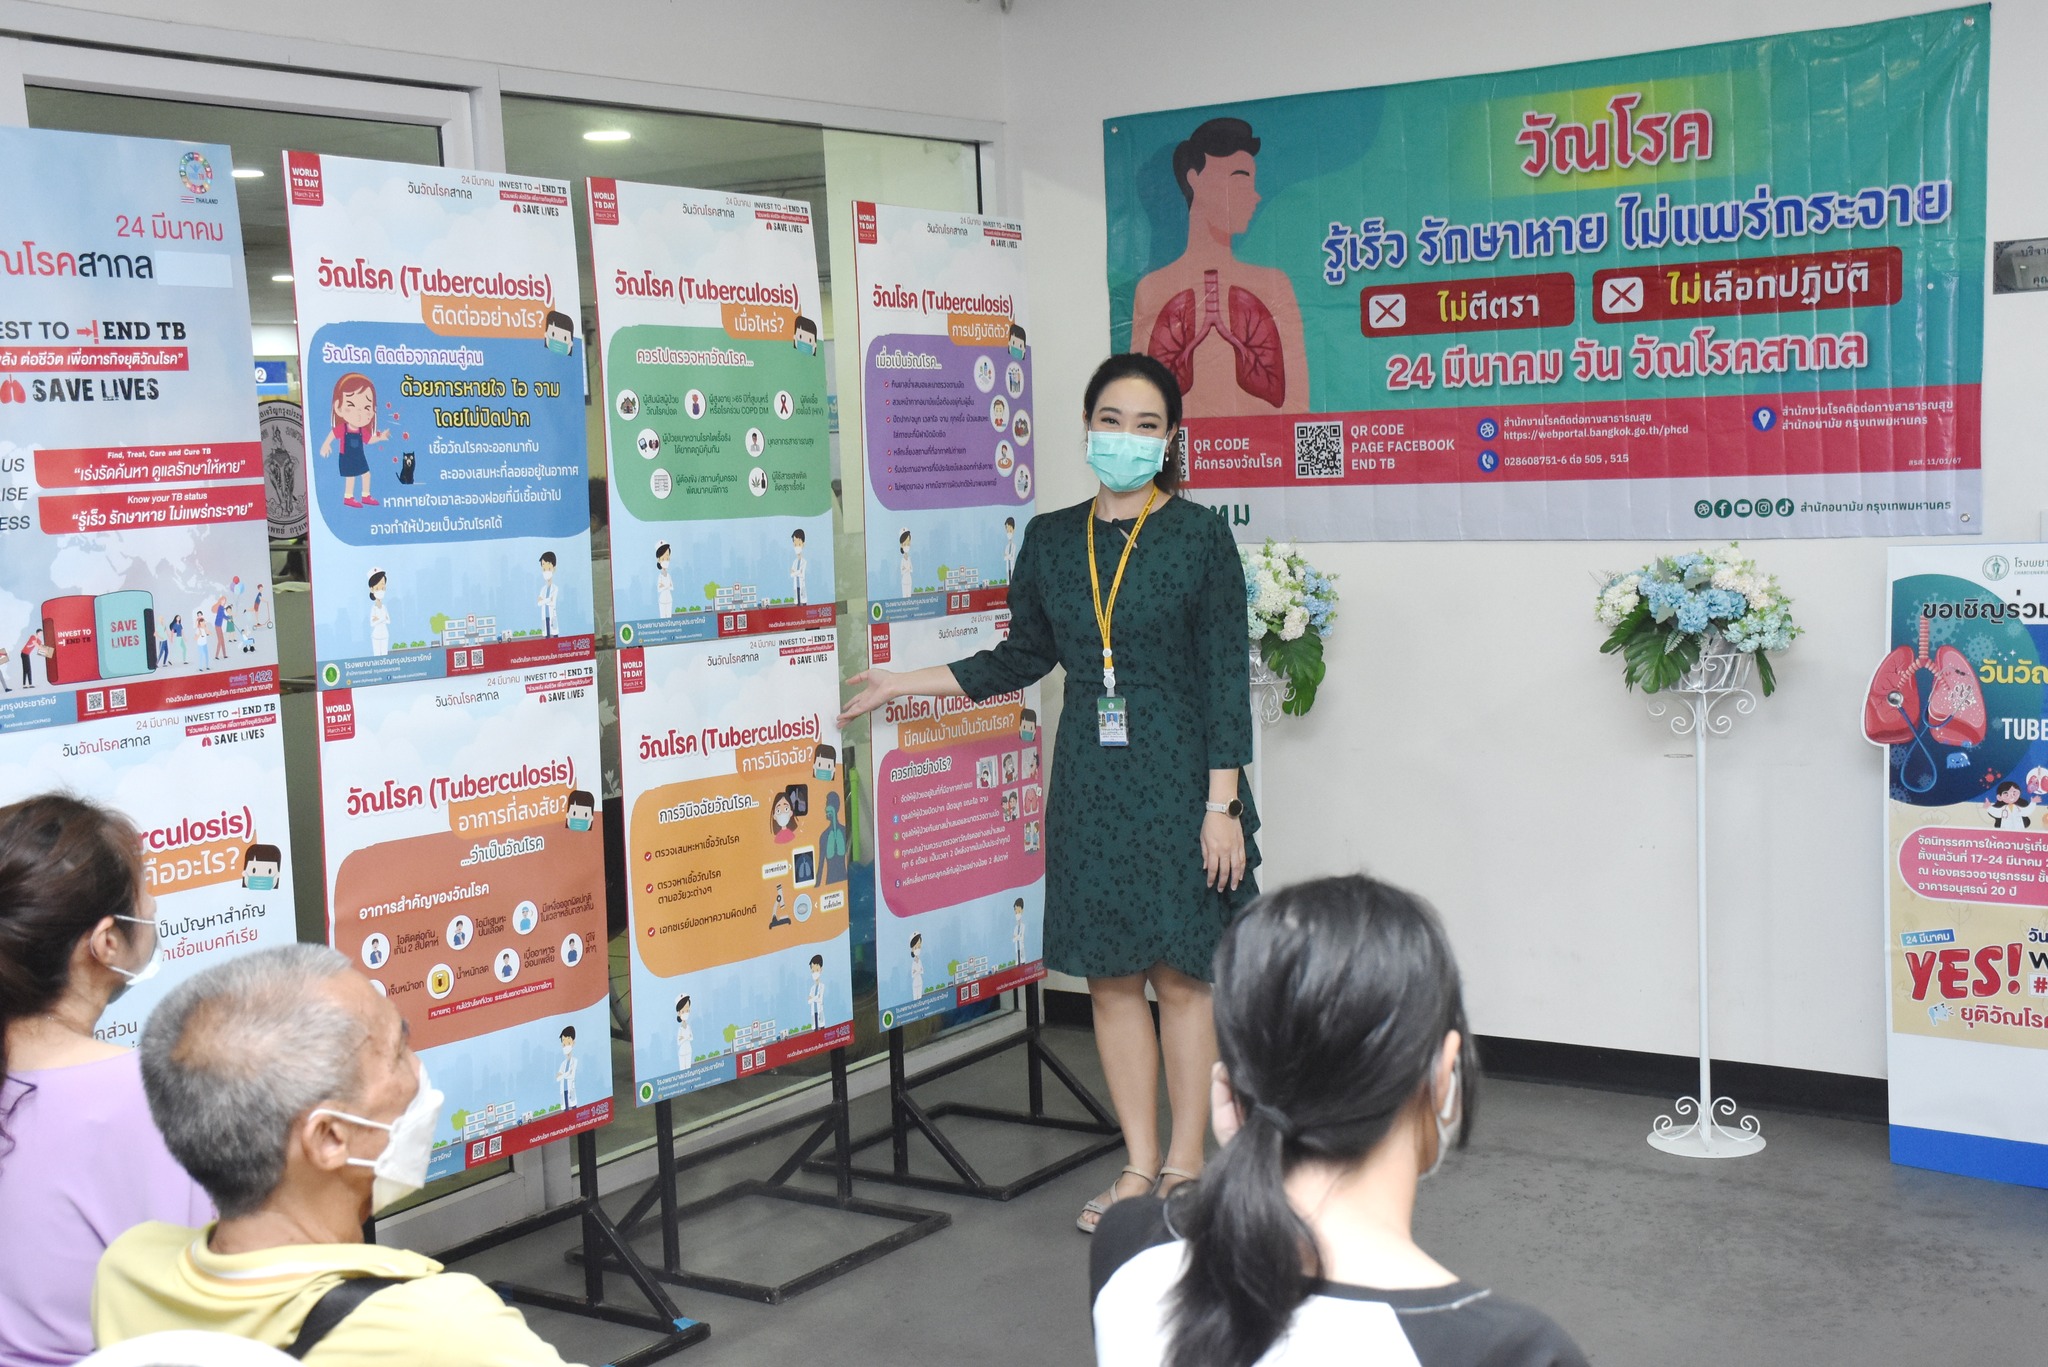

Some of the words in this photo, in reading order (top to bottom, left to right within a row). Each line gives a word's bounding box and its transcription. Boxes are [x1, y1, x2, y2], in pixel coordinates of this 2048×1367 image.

[1517, 94, 1711, 174] วัณโรค
[291, 167, 319, 178] WORLD
[293, 178, 304, 187] TB
[304, 179, 319, 188] DAY
[408, 181, 472, 199] วันวัณโรคสากล
[499, 181, 523, 190] INVEST
[594, 192, 615, 200] WORLD
[522, 204, 540, 215] SAVE
[595, 201, 603, 209] TB
[604, 202, 615, 210] DAY
[116, 215, 145, 238] 24
[152, 212, 223, 241] มีนาคม
[1323, 218, 1407, 285] รู้เร็ว
[1417, 213, 1607, 265] รักษาหาย
[1618, 182, 1951, 248] ไม่แพร่กระจาย
[318, 257, 393, 290] วัณโรค
[400, 265, 552, 304] (Tuberculosis)
[615, 269, 673, 298] วัณโรค
[679, 276, 799, 310] (Tuberculosis)
[1667, 262, 1869, 305] ไม่เลือกปฏิบัติ
[873, 284, 918, 309] วัณโรค
[922, 289, 1014, 318] (Tuberculosis)
[1437, 290, 1540, 323] ไม่ตีตรา
[432, 305, 545, 329] ติดต่ออย่างไร?
[734, 308, 784, 333] เมื่อไหร่?
[38, 321, 69, 340] TO
[103, 321, 150, 340] END
[157, 321, 186, 340] TB
[952, 323, 1010, 341] การปฏิบัติตัว?
[20, 350, 64, 367] ต่อชีวิต
[323, 346, 371, 363] วัณโรค
[376, 346, 483, 370] ติดต่อจากคนสู่คน
[1387, 354, 1434, 390] 24
[1444, 345, 1562, 388] มีนาคม
[1571, 338, 1622, 383] วัน
[1631, 327, 1867, 378] วัณโรคสากล
[32, 378, 94, 402] SAVE
[101, 377, 160, 401] LIVES
[400, 374, 506, 398] ด้วยการหายใจ
[512, 378, 528, 397] ไอ
[534, 379, 560, 398] จาม
[433, 407, 530, 428] โดยไม่ปิดปาก
[1782, 400, 1954, 418] สำนักงานโรคติดต่อทางสาธารณสุข
[1504, 414, 1652, 428] สำนักงานโรคติดต่อทางสาธารณสุข
[1782, 417, 1842, 431] สำนักอนามัย
[1845, 415, 1928, 431] กรุงเทพมหานคร
[1350, 425, 1368, 438] QR
[1371, 424, 1404, 436] CODE
[1503, 425, 1689, 440] https://webportal.bangkok.go.th/phcd
[107, 451, 125, 460] Find,
[127, 450, 147, 459] Treat,
[149, 449, 166, 458] Care
[168, 449, 181, 457] and
[183, 448, 200, 457] Cure
[202, 447, 211, 455] TB
[429, 436, 539, 455] เชื้อวัณโรคจะออกมากับ
[1193, 438, 1212, 451] QR
[1215, 438, 1250, 451] CODE
[1351, 442, 1384, 454] PAGE
[1387, 439, 1455, 452] FACEBOOK
[1194, 453, 1282, 470] คัดกรองวัณโรค
[1352, 459, 1377, 470] END
[1379, 458, 1395, 470] TB
[1504, 455, 1567, 467] 028608751-6
[1569, 455, 1583, 465] ต่อ
[1584, 454, 1602, 465] 505
[1610, 453, 1629, 464] 515
[1926, 456, 1962, 466] 11/01/67
[440, 461, 579, 481] ละอองเสมหะที่ลอยอยู่ในอากาศ
[127, 495, 150, 504] Know
[151, 495, 169, 505] your
[171, 493, 182, 501] TB
[184, 491, 207, 502] status
[383, 486, 561, 508] หากหายใจเอาละอองฝอยที่มีเชื้อเข้าไป
[1800, 500, 1864, 513] สำนักอนามัย
[1866, 499, 1952, 515] กรุงเทพมหานคร
[109, 509, 166, 525] รักษาหาย
[370, 515, 502, 535] อาจทำให้ป่วยเป็นวัณโรคได้
[110, 619, 137, 633] SAVE
[111, 634, 140, 649] LIVES
[622, 661, 643, 669] WORLD
[707, 653, 759, 666] วันวัณโรคสากล
[249, 670, 273, 684] 1422
[524, 673, 547, 682] INVEST
[623, 670, 631, 678] TB
[632, 669, 643, 677] DAY
[436, 690, 499, 707] วันวัณโรคสากล
[548, 691, 565, 702] SAVE
[567, 689, 584, 700] LIVES
[184, 711, 215, 723] INVEST
[216, 710, 229, 720] TO
[242, 705, 262, 715] END
[264, 703, 276, 713] TB
[325, 704, 351, 714] WORLD
[886, 695, 930, 723] วัณโรค
[136, 720, 149, 732] 24
[149, 715, 180, 730] มีนาคม
[326, 715, 337, 724] TB
[337, 714, 351, 723] DAY
[214, 732, 239, 745] SAVE
[240, 728, 265, 741] LIVES
[639, 728, 697, 759] วัณโรค
[702, 713, 820, 756] (Tuberculosis)
[904, 713, 1015, 747] มีคนในบ้านเป็นวัณโรค?
[62, 735, 151, 757] วันวัณโรคสากล
[742, 746, 813, 772] การวินิจฉัย?
[891, 757, 951, 781] ควรทำอย่างไร?
[347, 780, 423, 816] วัณโรค
[429, 756, 575, 808] (Tuberculosis)
[459, 794, 567, 831] อาการที่สงสัย?
[655, 834, 740, 859] ตรวจเสมหะหาเชื้อวัณโรค
[1918, 848, 1968, 863] ตั้งแต่วันที่
[1971, 854, 2003, 865] 17-24
[2006, 854, 2042, 867] มีนาคม
[657, 869, 722, 890] ตรวจหาเชื้อวัณโรค
[1918, 866, 1929, 875] ณ
[1932, 863, 2035, 883] ห้องตรวจอายุรกรรม
[658, 885, 712, 904] ตามอวัยวะต่างๆ
[1918, 882, 1987, 895] อาคารอนุสรณ์
[1990, 886, 2005, 896] 20
[2008, 885, 2017, 897] ปี
[359, 882, 490, 919] อาการสำคัญของวัณโรค
[1905, 936, 1918, 944] 24
[1919, 931, 1951, 944] มีนาคม
[1905, 943, 2023, 1000] YES!
